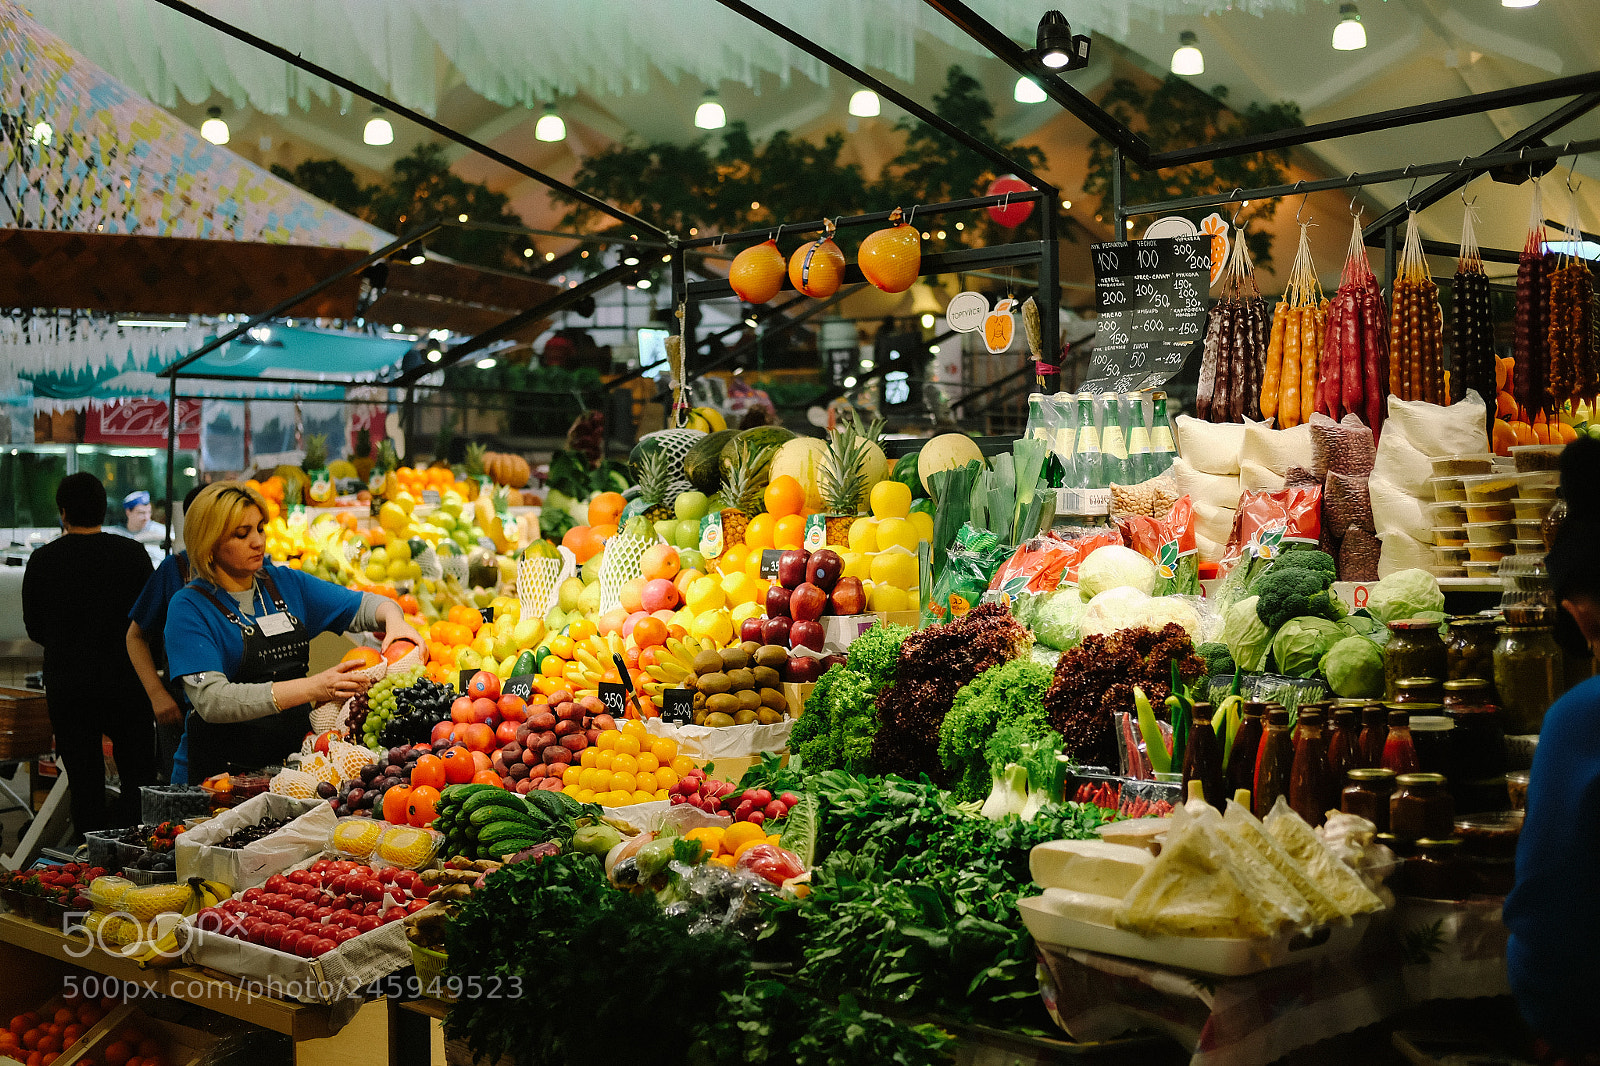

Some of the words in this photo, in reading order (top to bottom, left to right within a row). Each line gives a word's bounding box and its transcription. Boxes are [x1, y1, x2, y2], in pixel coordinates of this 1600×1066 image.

[1137, 249, 1159, 269] 100
[1101, 311, 1122, 319] МАСЛО
[1129, 351, 1146, 369] 50
